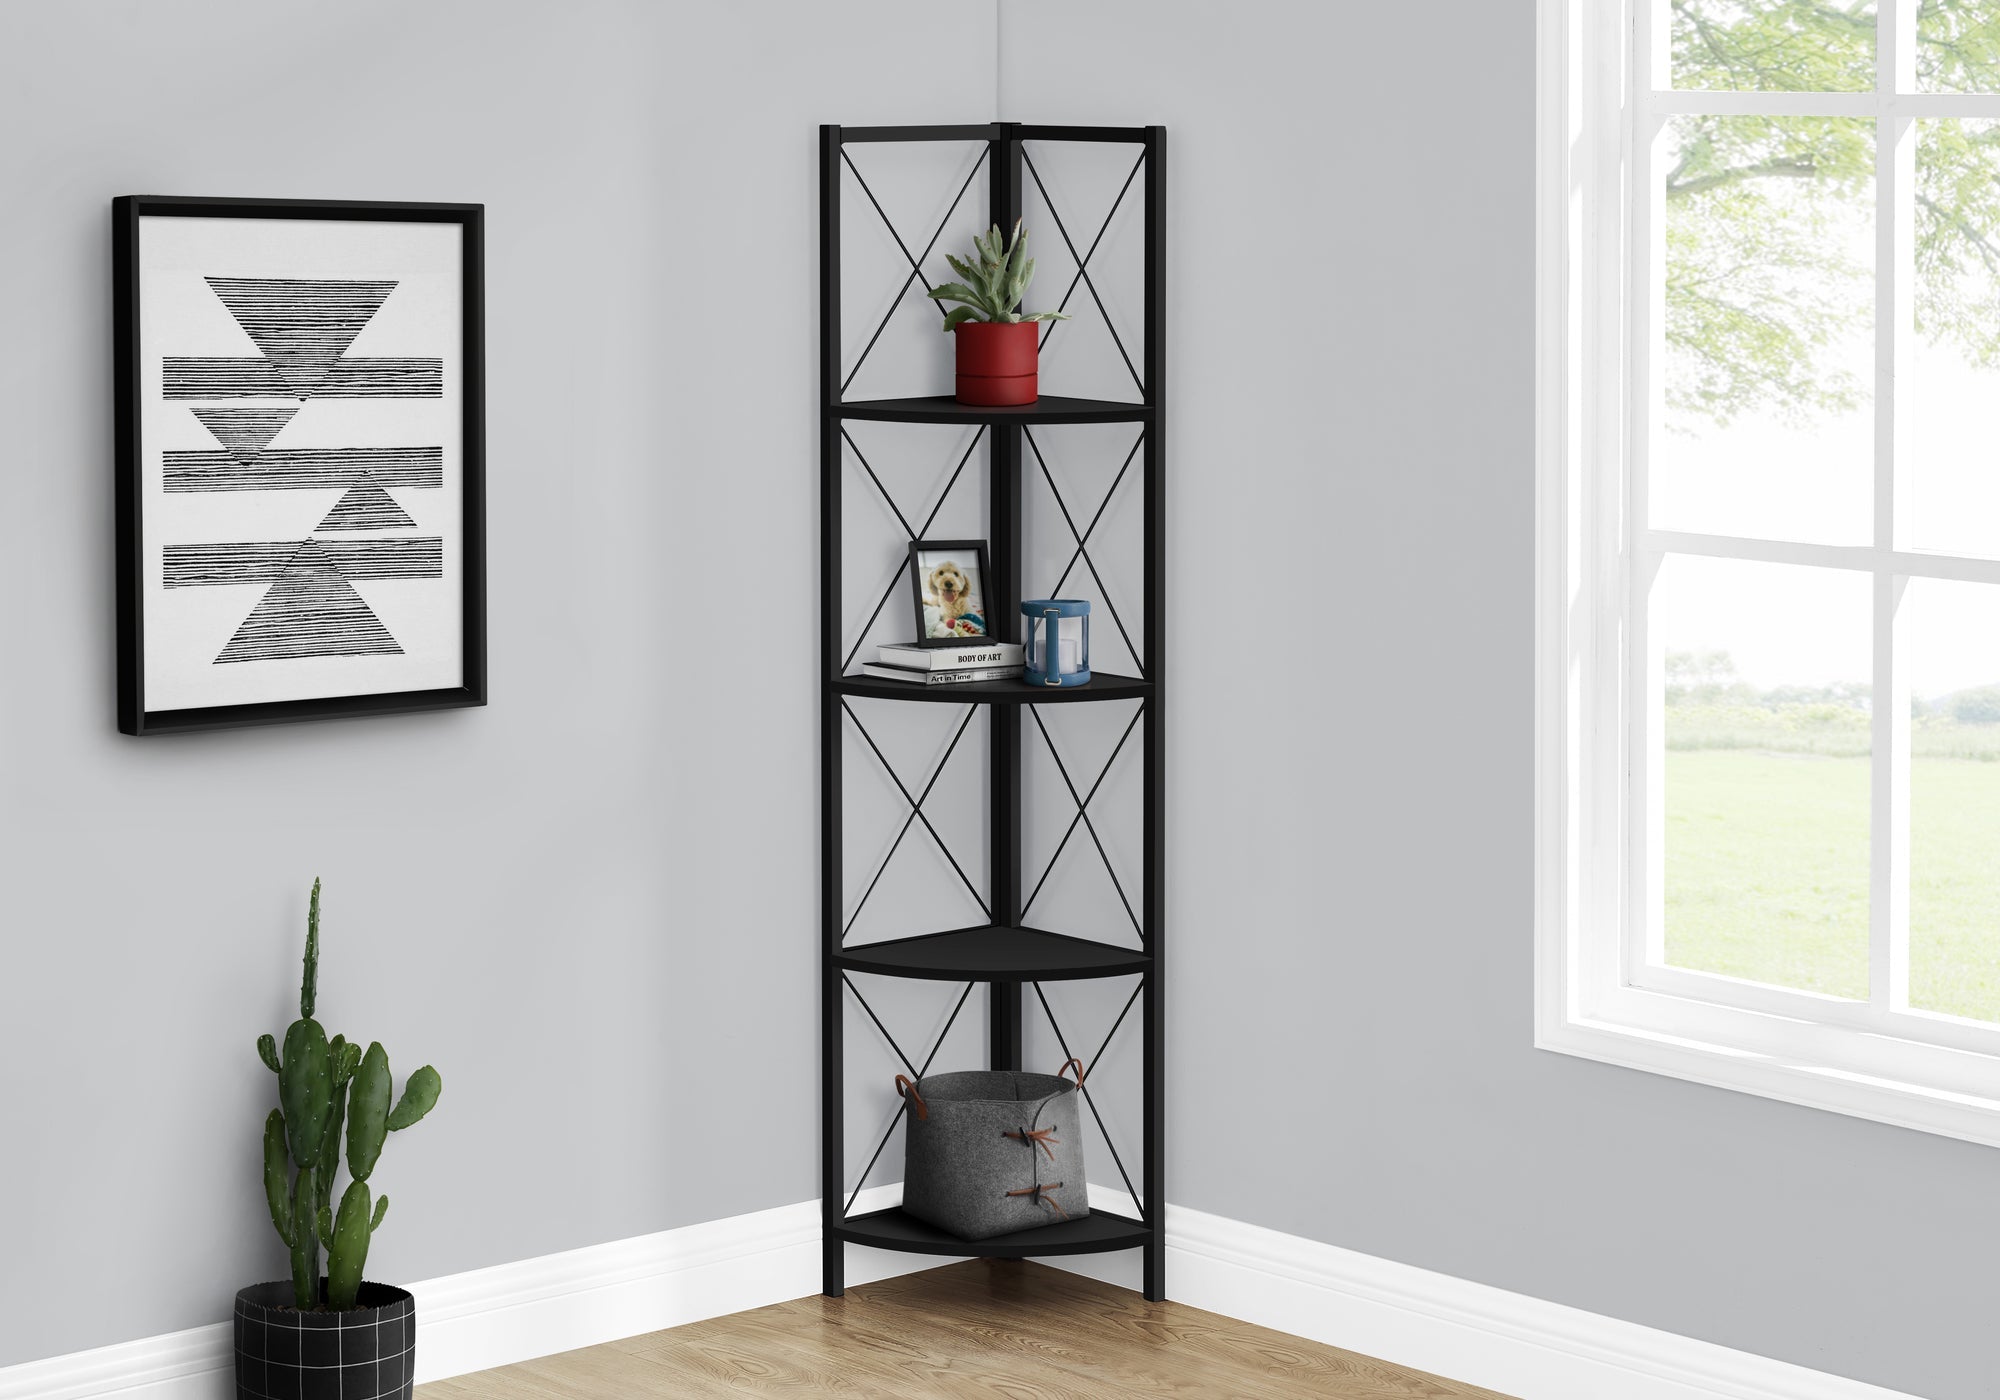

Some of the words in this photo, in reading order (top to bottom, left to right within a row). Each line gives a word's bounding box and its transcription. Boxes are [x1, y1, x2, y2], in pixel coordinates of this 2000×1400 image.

[958, 654, 977, 663] BODY
[977, 653, 986, 662] OF
[987, 653, 1002, 661] ART
